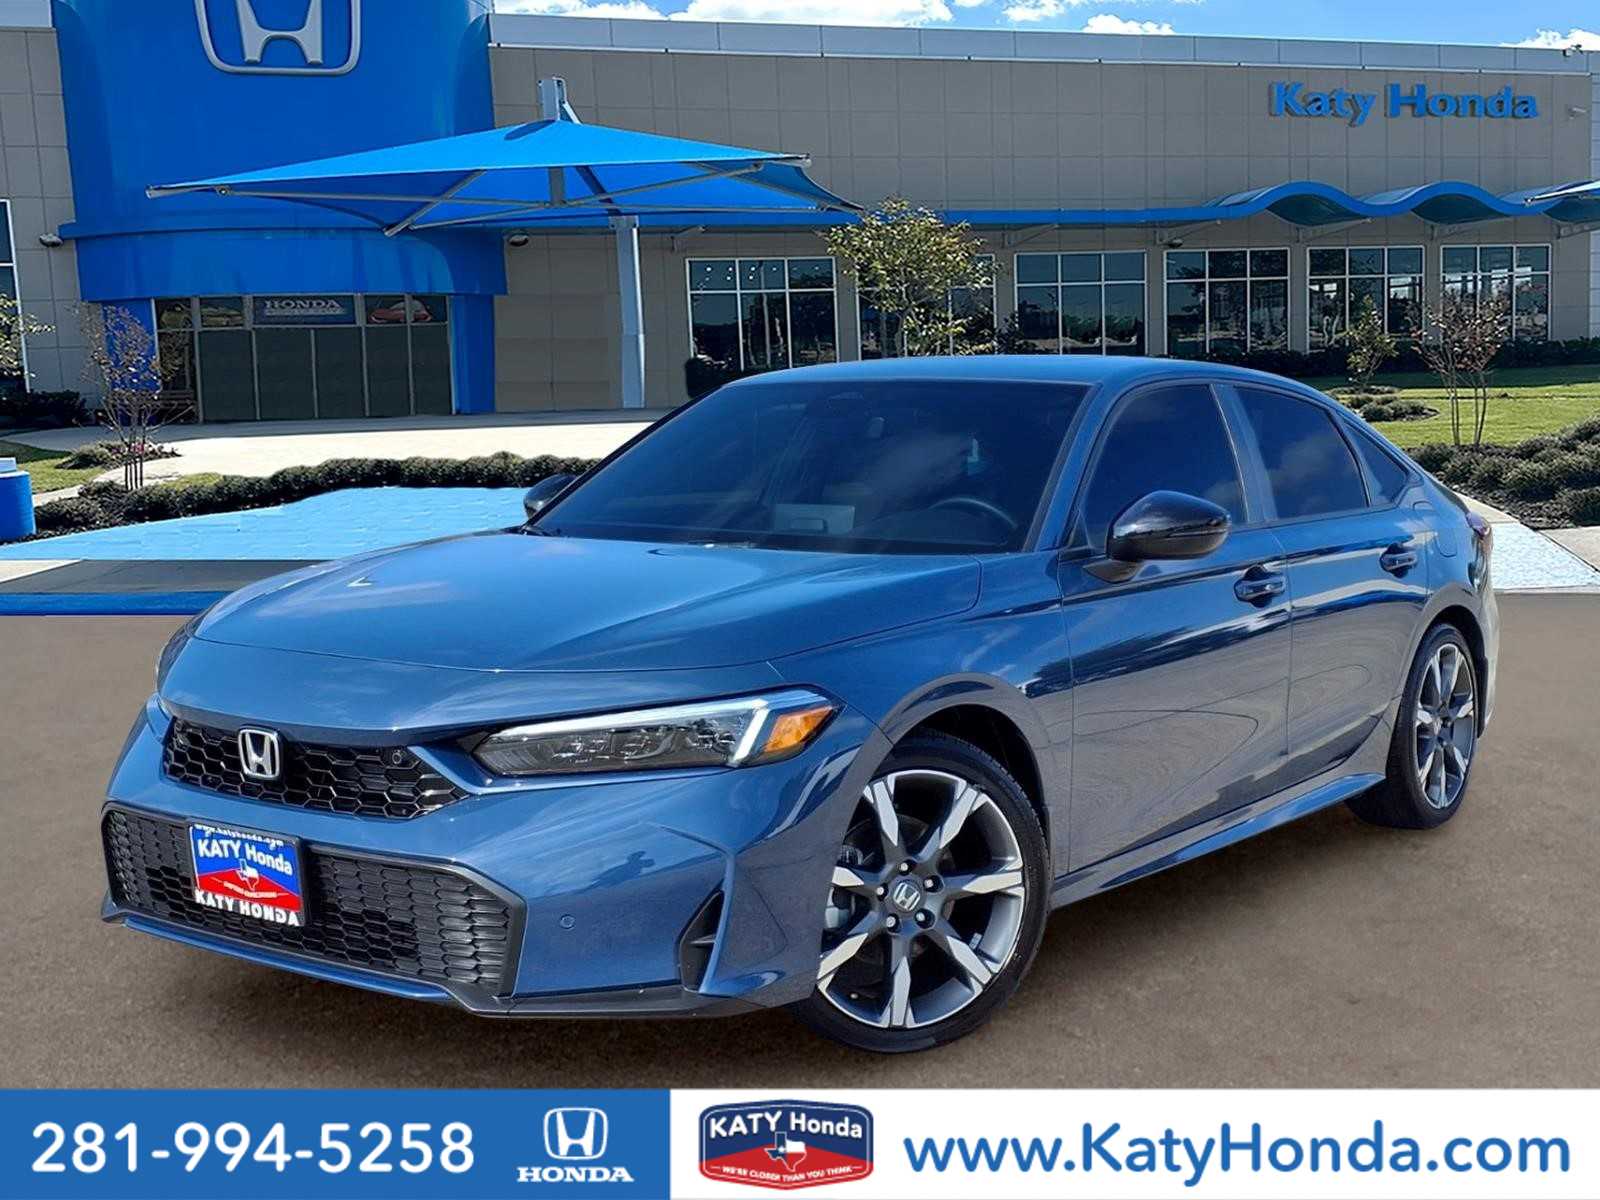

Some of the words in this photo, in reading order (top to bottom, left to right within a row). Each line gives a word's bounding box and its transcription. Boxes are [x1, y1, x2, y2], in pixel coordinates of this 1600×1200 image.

[1270, 82, 1377, 127] Katy
[1385, 83, 1539, 119] Honda
[264, 299, 341, 309] HONDA
[197, 838, 241, 859] KATY
[245, 842, 293, 876] Honda
[194, 888, 234, 912] KATY
[240, 899, 301, 927] HONDA
